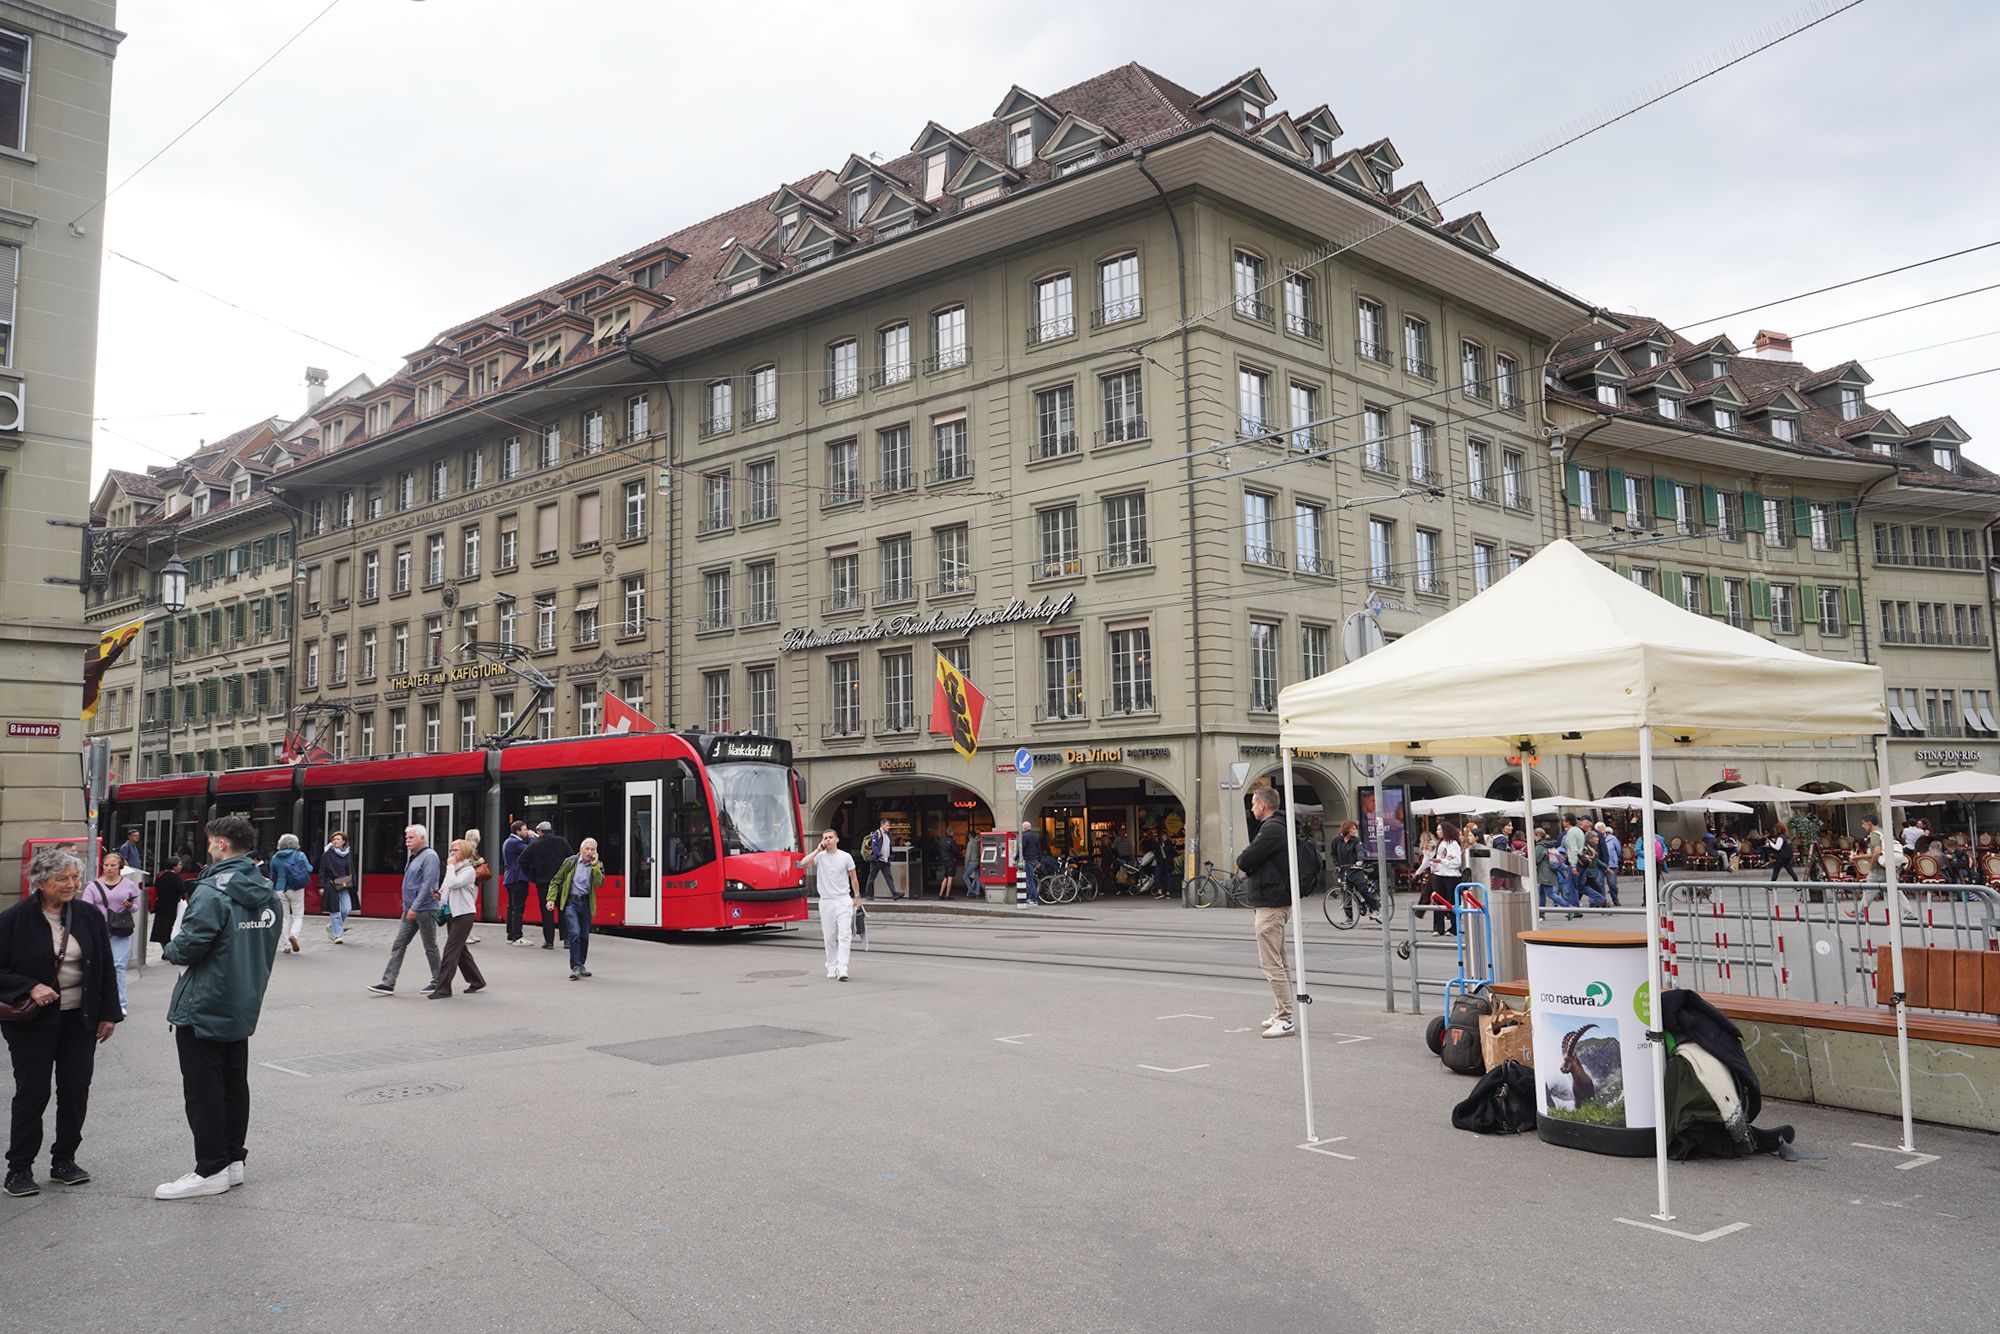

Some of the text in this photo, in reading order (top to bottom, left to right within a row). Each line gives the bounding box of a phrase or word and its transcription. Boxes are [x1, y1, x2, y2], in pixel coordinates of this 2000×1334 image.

[777, 591, 1076, 653] Schweizerische Treuhandgesellschaft
[391, 673, 429, 690] THEATER
[434, 675, 446, 684] AM
[10, 724, 58, 736] Bärenplatz
[1064, 749, 1086, 763] Da
[1087, 747, 1122, 762] Vinci
[1541, 992, 1596, 1006] pro natura
